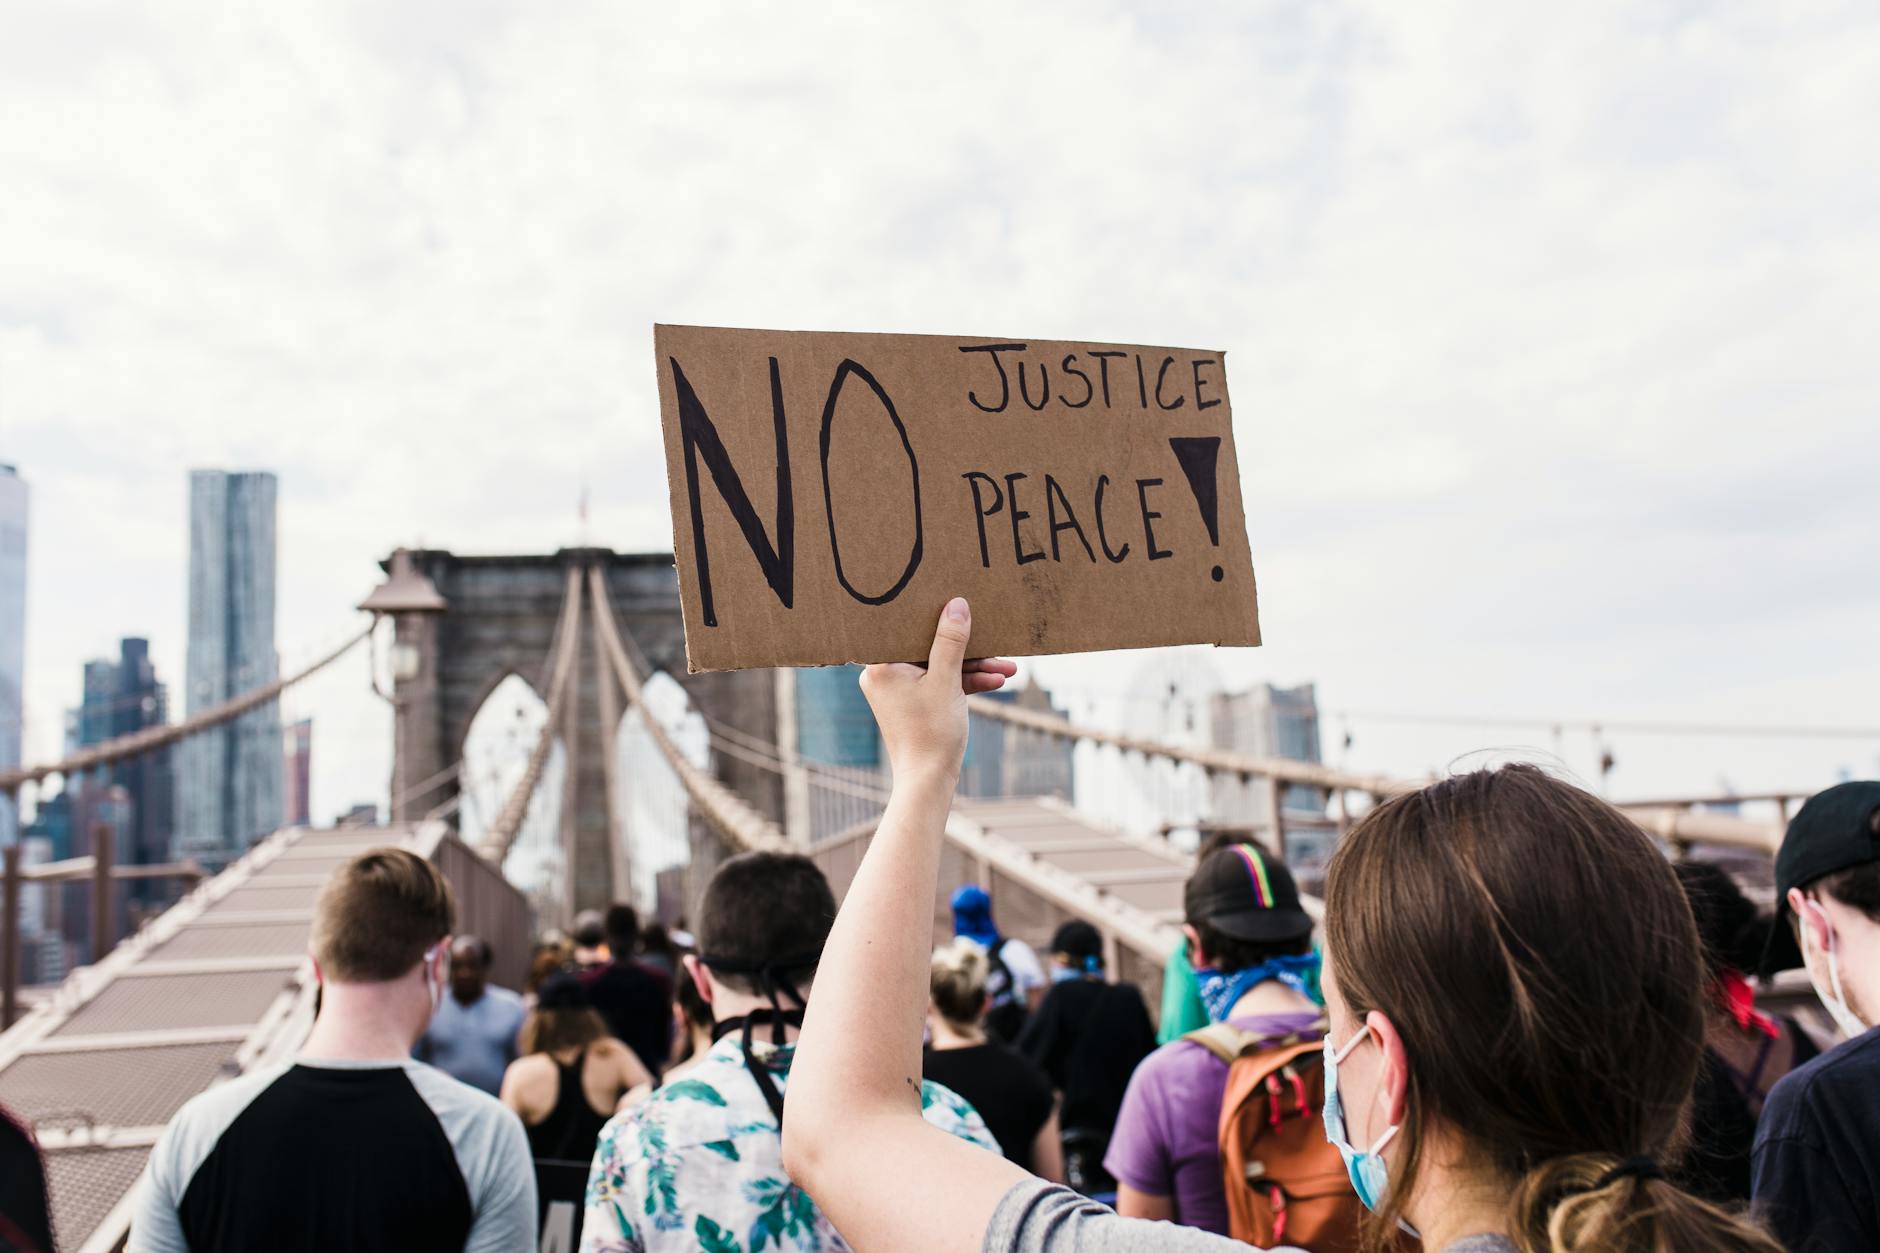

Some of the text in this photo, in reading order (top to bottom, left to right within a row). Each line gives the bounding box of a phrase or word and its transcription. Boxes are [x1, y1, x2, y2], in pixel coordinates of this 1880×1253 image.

[957, 343, 1223, 413] JUSTICE
[669, 355, 924, 628] NO
[961, 436, 1224, 583] PEACE!
